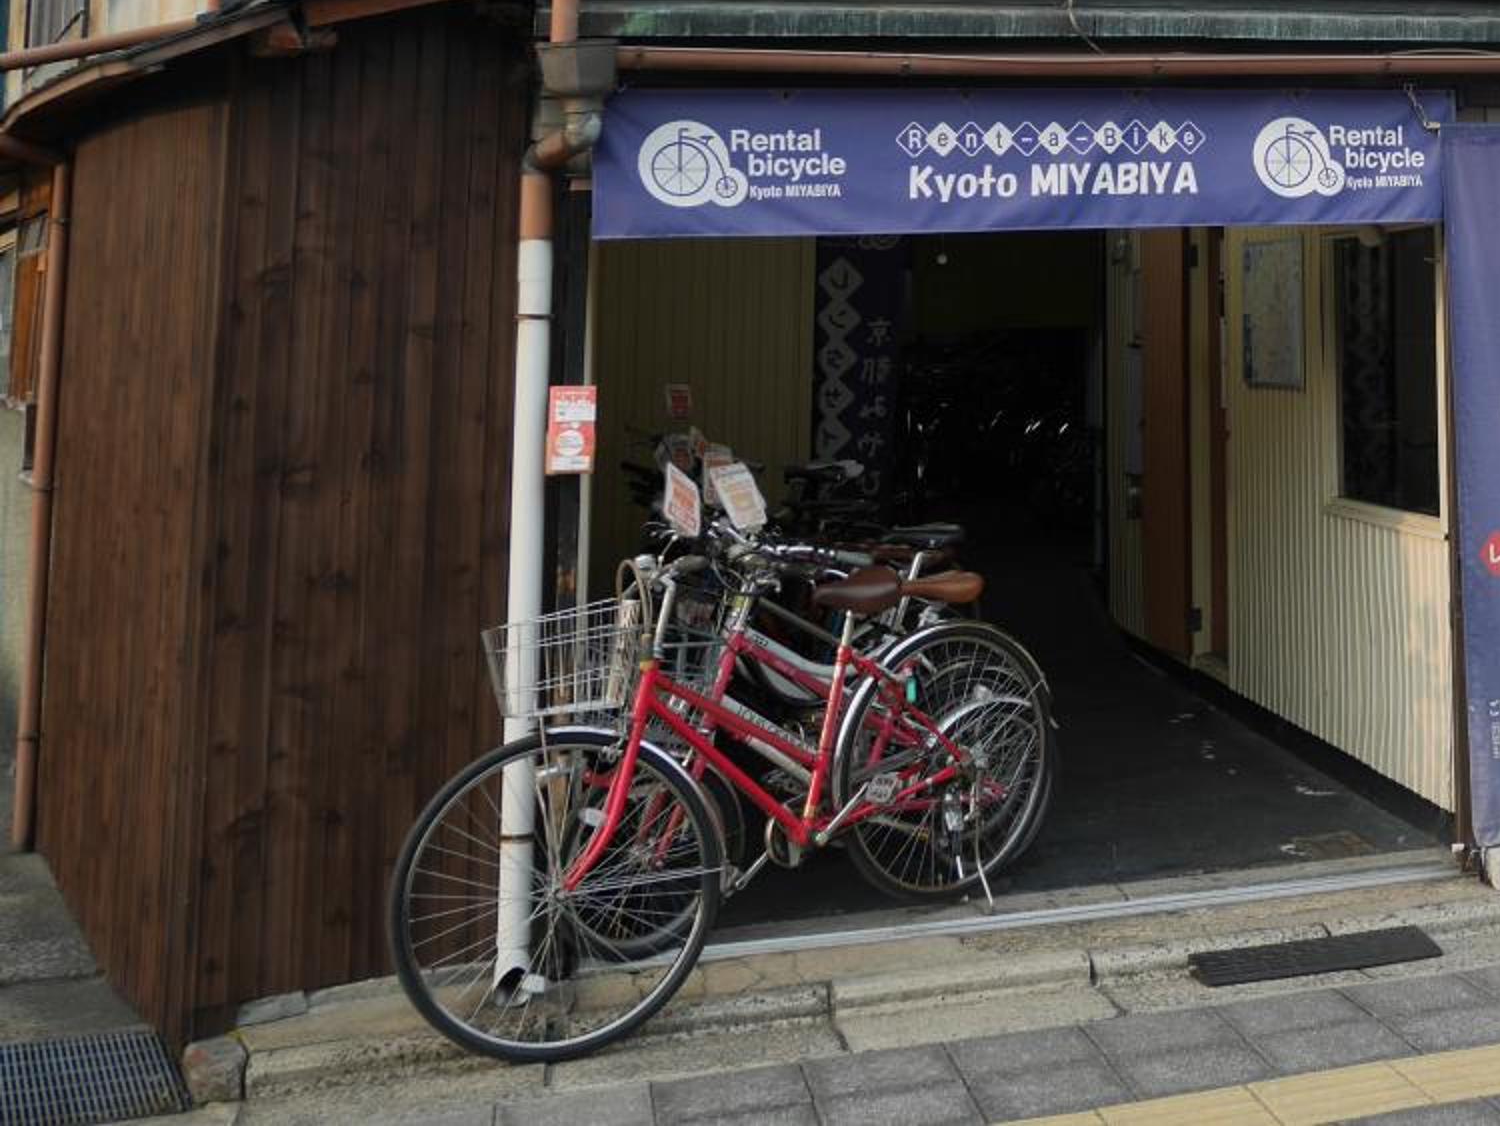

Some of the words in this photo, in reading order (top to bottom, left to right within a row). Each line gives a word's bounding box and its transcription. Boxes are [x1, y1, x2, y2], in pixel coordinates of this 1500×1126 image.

[731, 129, 821, 153] Rental
[903, 124, 1198, 153] Rent-a-Bike
[1329, 125, 1403, 148] Rental
[748, 153, 847, 183] bicycle
[1345, 146, 1425, 172] bicycle
[749, 185, 783, 201] Kyoto
[785, 183, 841, 199] MIYABIYA
[909, 165, 1017, 203] Kyoto
[1030, 162, 1198, 197] MIYABIYA
[1375, 174, 1423, 189] MIYABIYA
